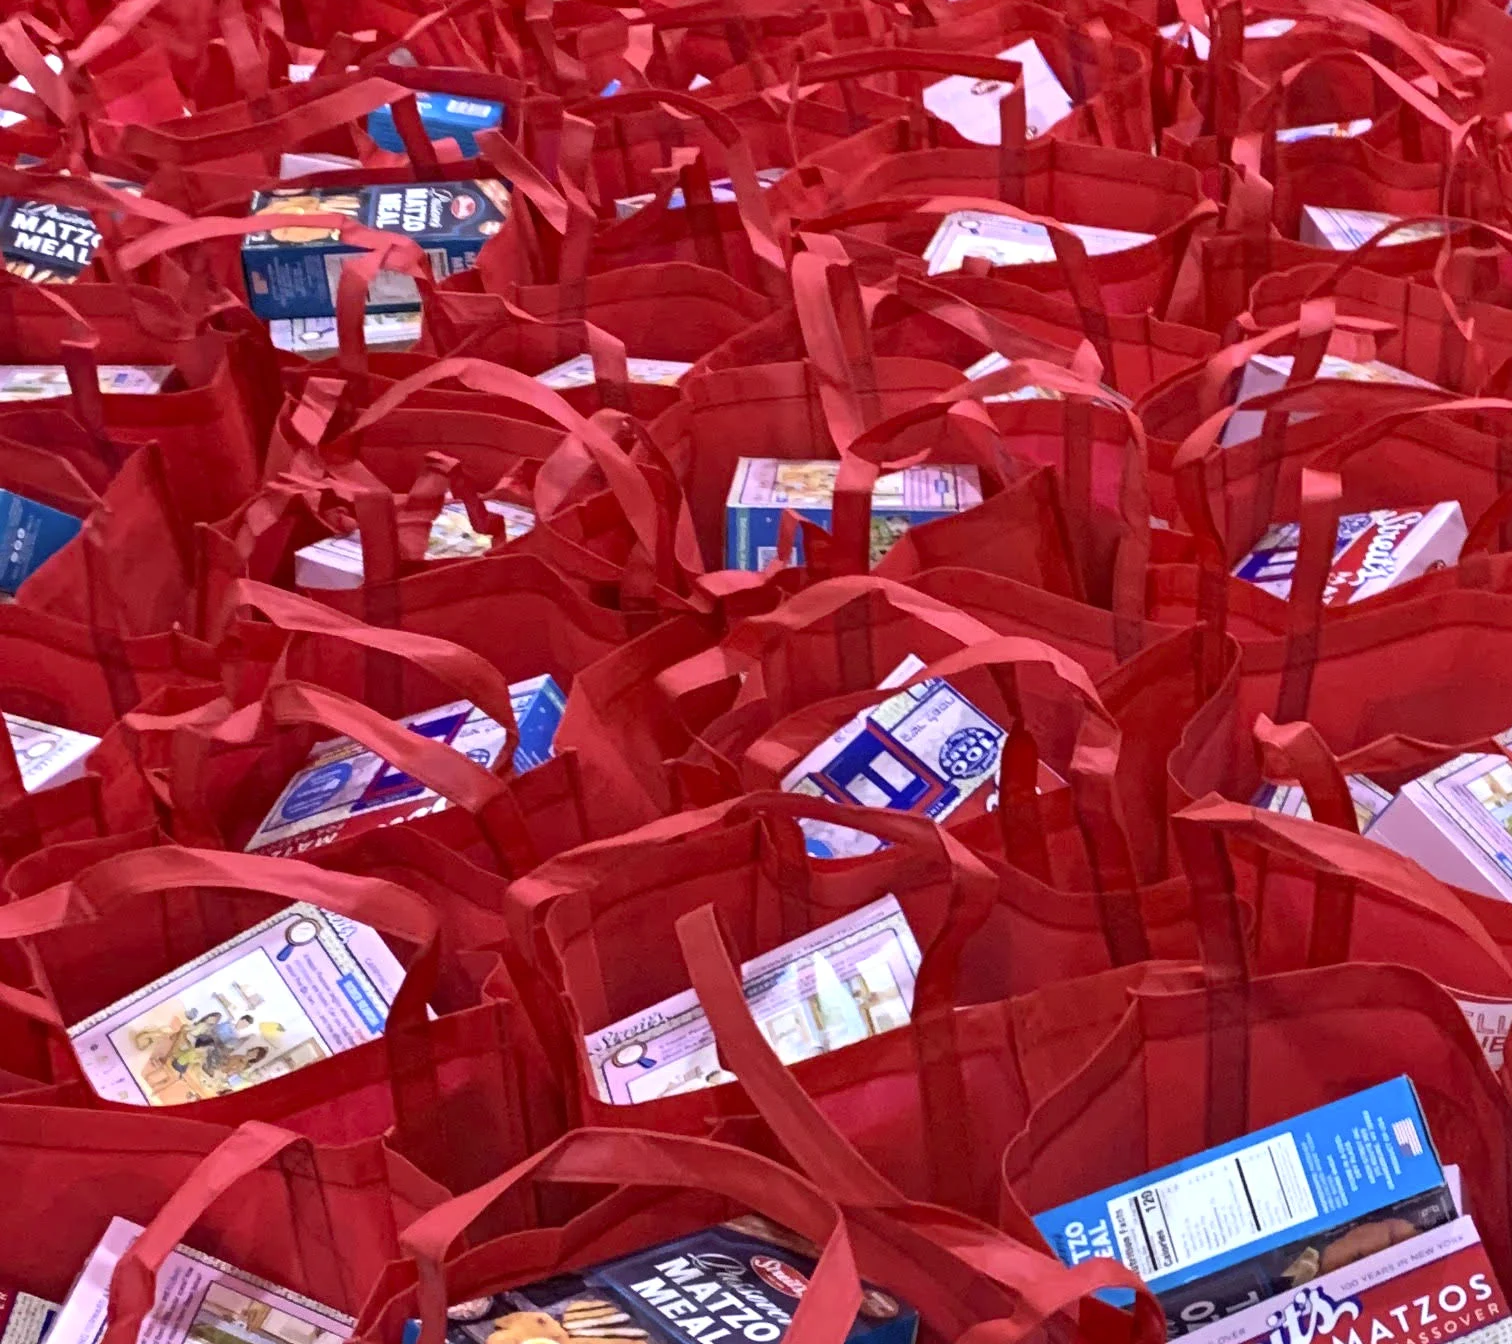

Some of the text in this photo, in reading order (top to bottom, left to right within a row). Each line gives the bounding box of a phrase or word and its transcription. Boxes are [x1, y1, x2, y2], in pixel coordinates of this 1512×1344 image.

[13, 231, 92, 266] MEAL
[1143, 1189, 1156, 1215] 120
[1361, 1263, 1396, 1286] YEARS
[1409, 1247, 1436, 1265] NEW
[653, 1255, 782, 1344] MATZO
